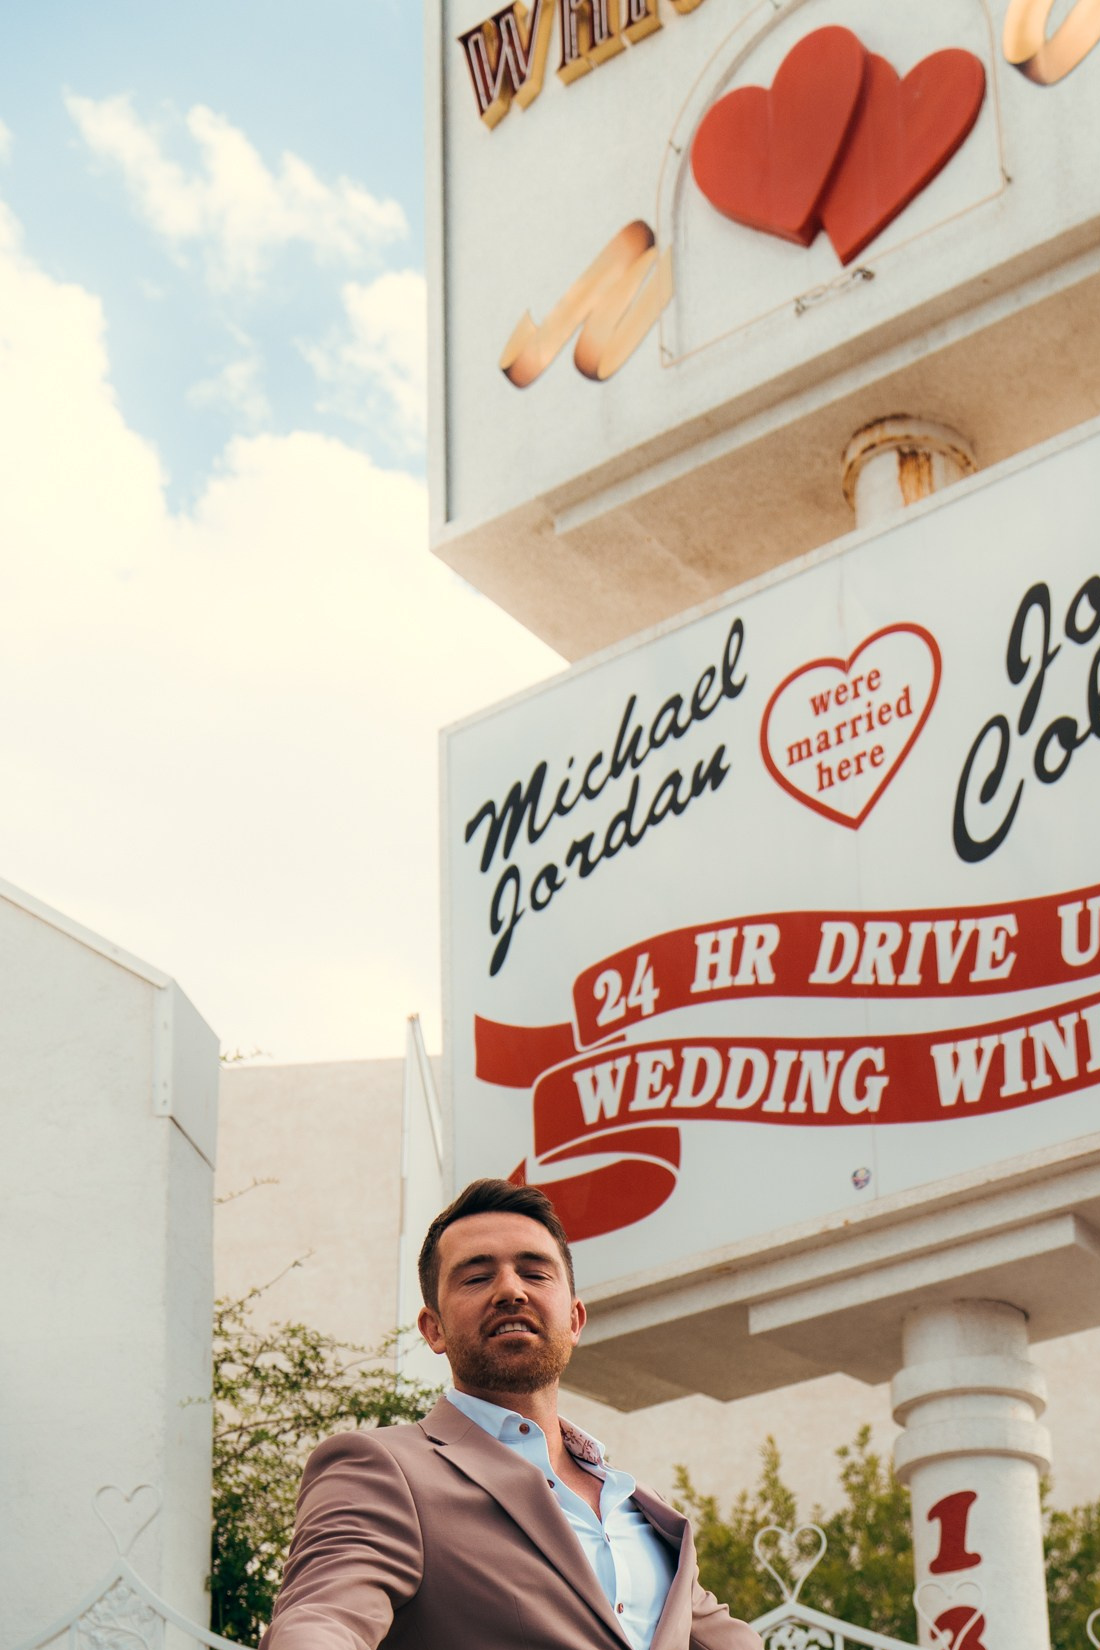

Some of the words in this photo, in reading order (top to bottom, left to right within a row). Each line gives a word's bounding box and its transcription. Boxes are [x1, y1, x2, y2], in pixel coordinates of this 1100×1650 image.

[786, 686, 914, 766] married
[808, 666, 882, 717] were
[464, 617, 749, 873] Michael
[815, 743, 885, 793] here
[488, 743, 731, 977] Jordan
[593, 952, 659, 1026] 24
[690, 922, 782, 995] HR
[808, 914, 1019, 988] DRIVE
[572, 1046, 889, 1126] WEDDING
